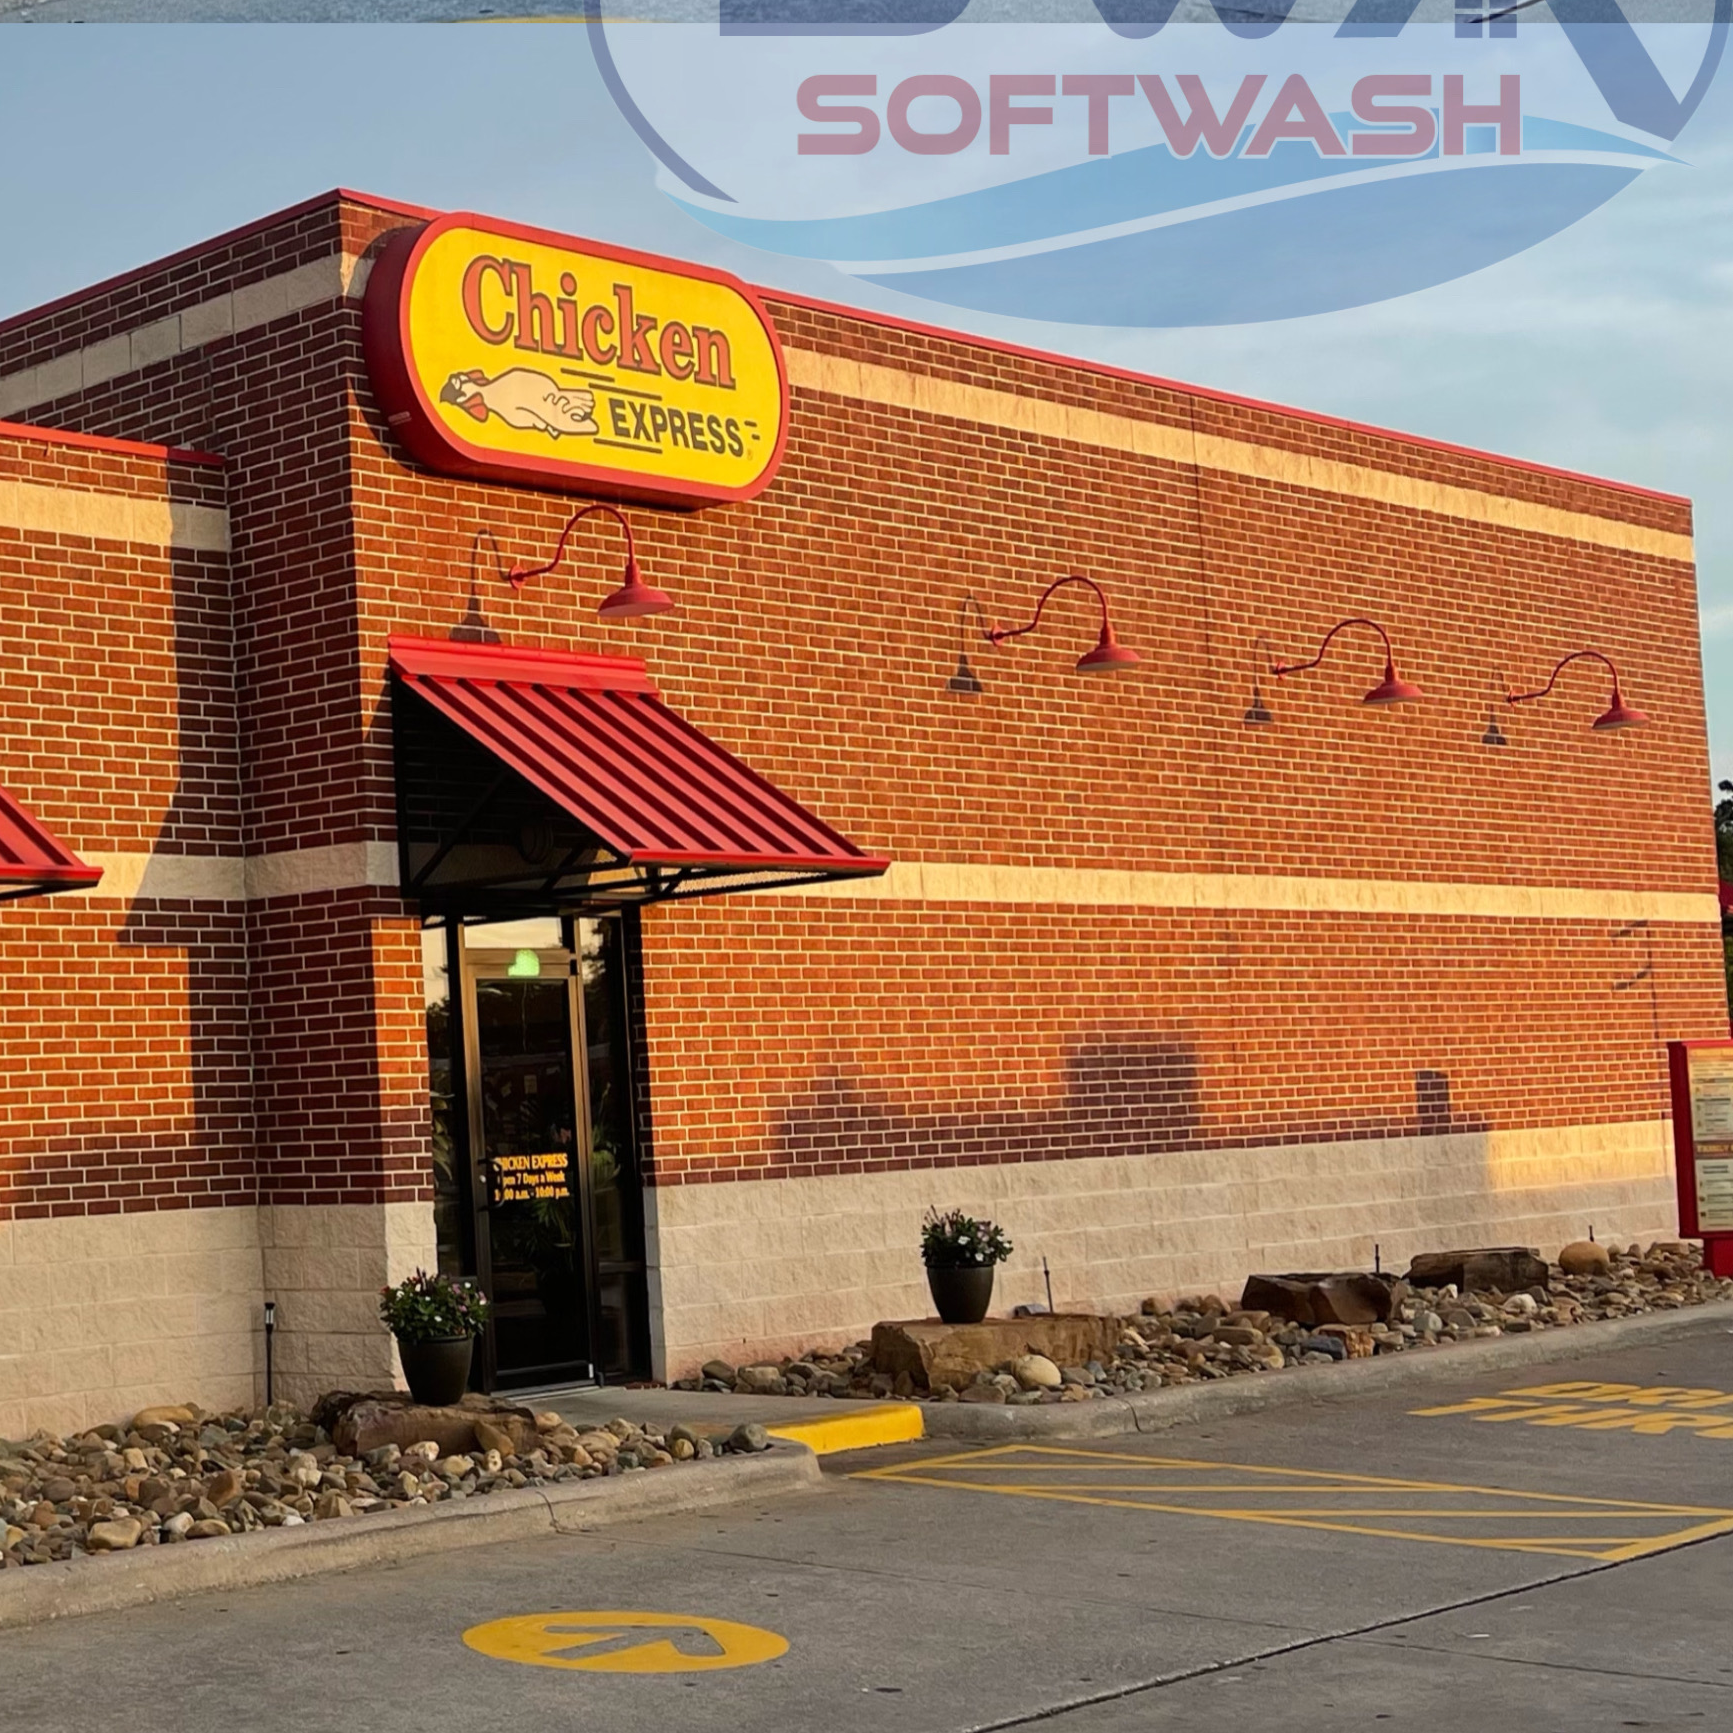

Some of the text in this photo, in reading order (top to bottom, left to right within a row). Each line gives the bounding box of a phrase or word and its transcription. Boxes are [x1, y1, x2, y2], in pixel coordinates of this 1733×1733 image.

[462, 255, 737, 390] Chicken
[608, 397, 744, 458] EXPRESS
[497, 1175, 516, 1189] pen
[516, 1172, 522, 1185] 7
[523, 1172, 539, 1187] Days
[545, 1170, 566, 1183] Week
[531, 1152, 569, 1169] EXPRESS
